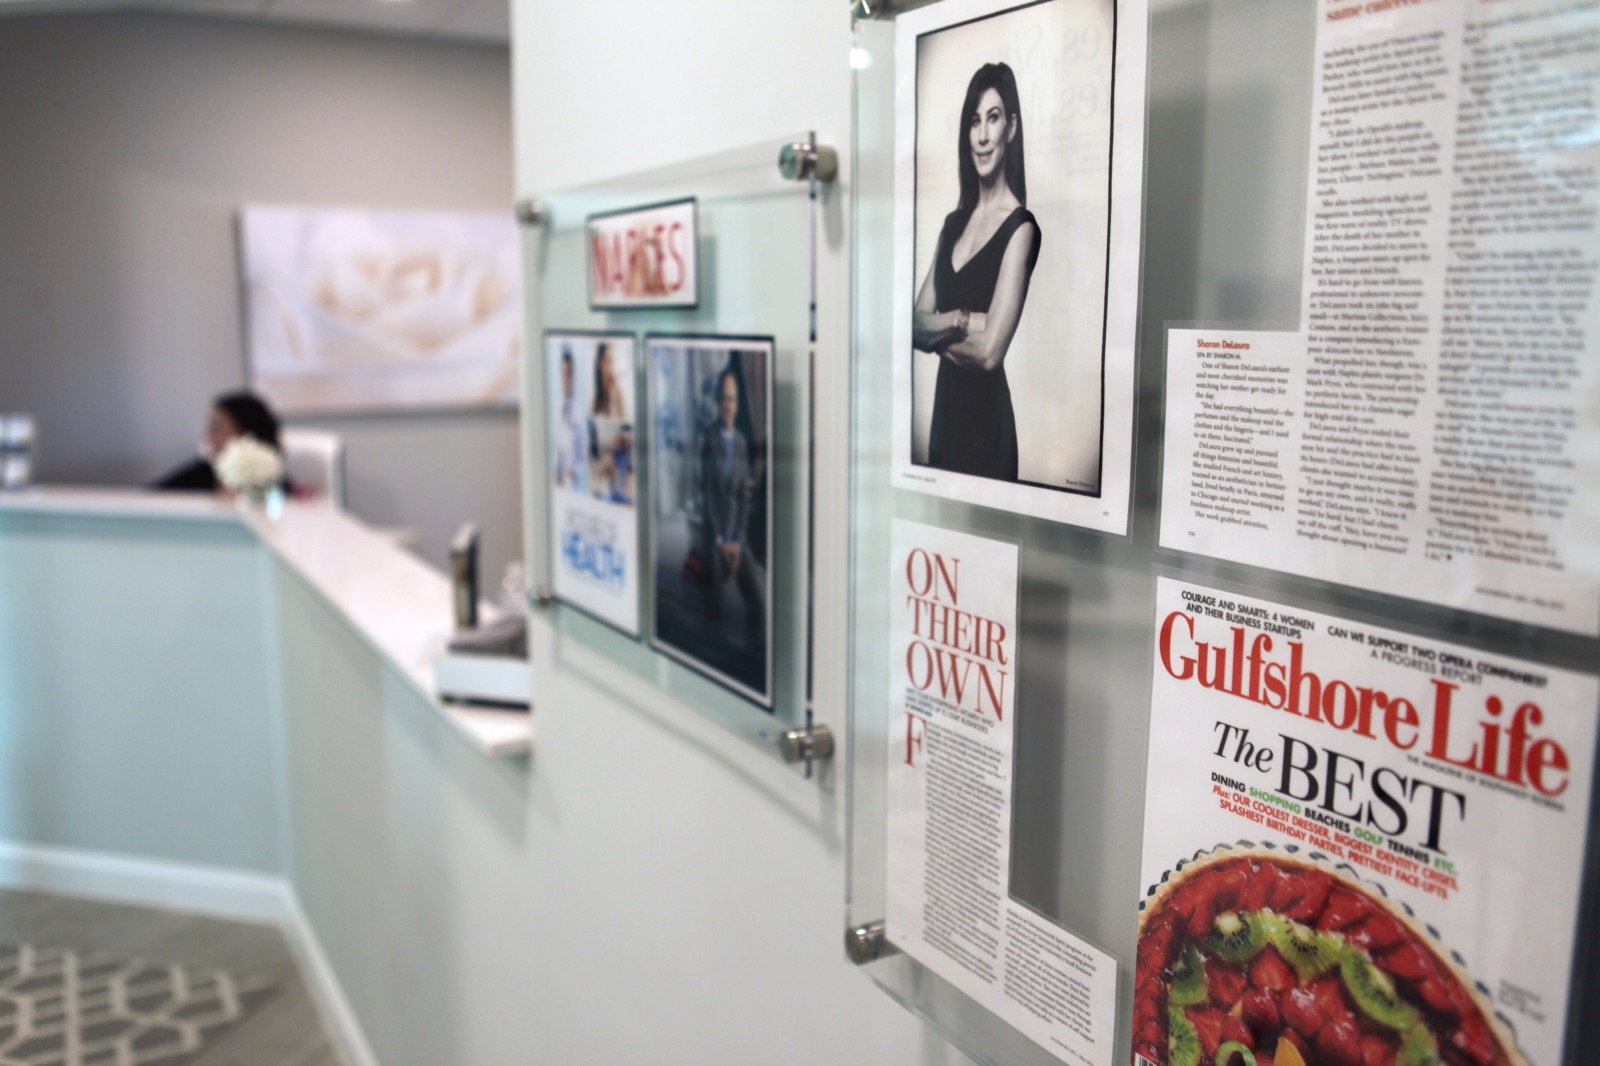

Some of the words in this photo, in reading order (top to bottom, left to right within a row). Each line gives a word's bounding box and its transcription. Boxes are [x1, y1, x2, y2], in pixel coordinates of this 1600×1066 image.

[1197, 339, 1220, 348] Sharon
[1222, 340, 1250, 349] DeLaura
[1196, 382, 1219, 391] watching
[1261, 387, 1276, 396] ready
[1224, 406, 1252, 414] everything
[1199, 442, 1220, 450] DeLaura
[1201, 452, 1216, 461] things
[1218, 454, 1240, 463] feminine
[1223, 465, 1241, 473] French
[1190, 500, 1213, 510] freelance
[1214, 505, 1235, 515] makeup
[1198, 491, 1218, 502] Chicago
[1250, 501, 1273, 511] working
[1219, 484, 1235, 495] briefly
[1220, 516, 1242, 525] grabbed
[906, 548, 960, 606] ON
[1181, 590, 1216, 606] COURAGE
[1218, 600, 1235, 611] AND
[1238, 604, 1270, 619] SMARTS:
[1272, 612, 1278, 622] 4
[1280, 613, 1315, 631] WOMEN
[1186, 603, 1202, 614] AND
[1205, 607, 1224, 619] THEIR
[1226, 612, 1261, 630] BUSINESS
[1264, 622, 1302, 640] STARTUPS
[907, 595, 1008, 665] THEIR
[1327, 625, 1348, 639] CAN
[1350, 631, 1365, 643] WE
[1368, 636, 1408, 654] SUPPORT
[1411, 645, 1436, 661] TWO
[1439, 652, 1472, 669] OPERA
[906, 640, 1008, 722] OWN
[1370, 650, 1377, 659] A
[1381, 652, 1437, 674] PROGRESS
[1441, 666, 1484, 686] REPORT
[1158, 610, 1420, 751] Gulfshore
[1425, 678, 1570, 798] Life
[904, 712, 927, 768] F
[1214, 721, 1273, 773] The
[1274, 733, 1466, 856] BEST
[1211, 772, 1246, 792] DINING
[1249, 786, 1301, 814] SHOPPING
[1305, 807, 1350, 833] BEACHES
[1354, 827, 1384, 845] GOLF
[1387, 839, 1430, 864] TENNIS
[1213, 785, 1230, 799] Plus:
[1232, 793, 1250, 807] OUR
[1253, 801, 1290, 822] COOLEST
[1292, 815, 1331, 840] DRESSER,
[1334, 832, 1373, 856] BIGGEST
[1376, 849, 1419, 873] IDENTITY
[1220, 799, 1264, 824] SPLASHIEST
[1266, 818, 1306, 841] BIRTHDAY
[1309, 835, 1345, 858] PARTIES,
[1348, 850, 1393, 877] PRETTIEST
[1395, 870, 1448, 900] FACE-LIFTS
